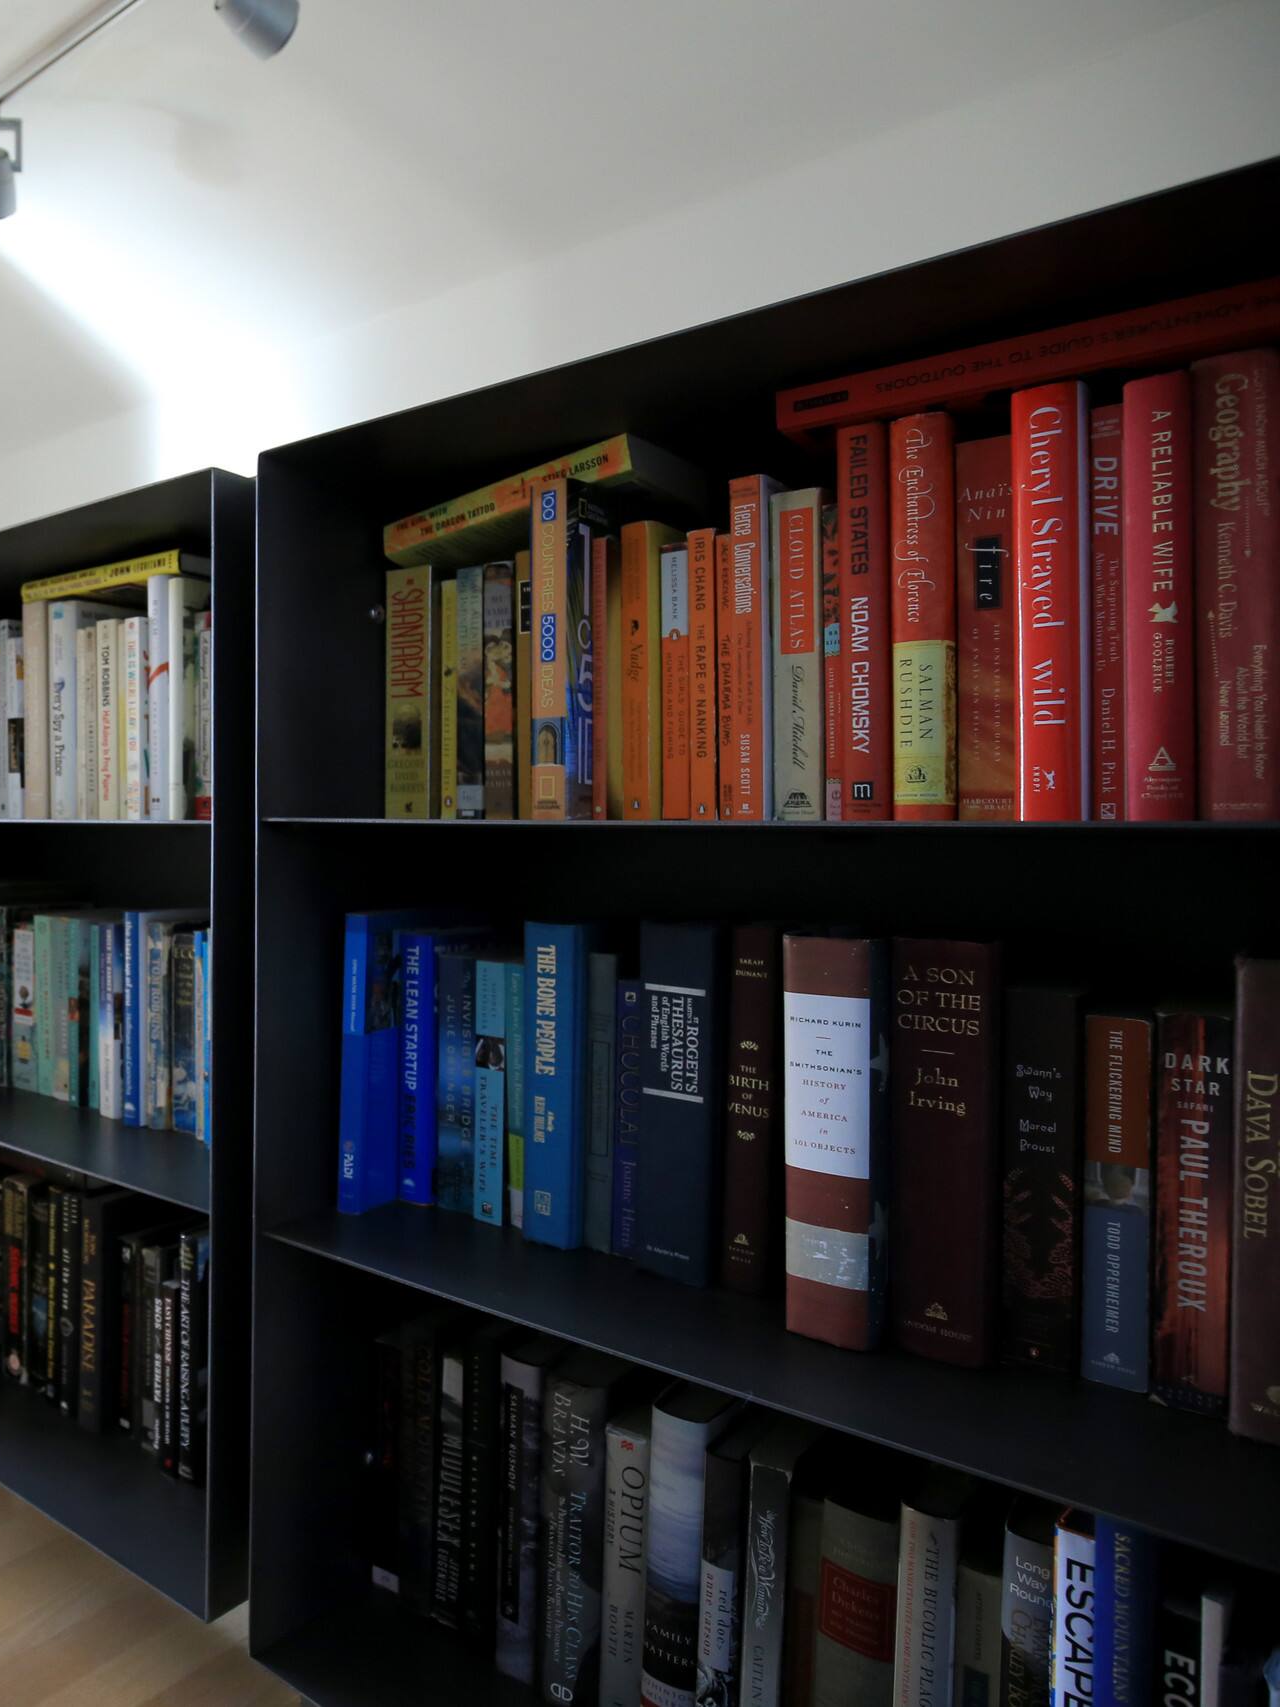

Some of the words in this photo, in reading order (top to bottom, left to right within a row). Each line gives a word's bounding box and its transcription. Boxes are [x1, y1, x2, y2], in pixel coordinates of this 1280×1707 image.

[1151, 410, 1173, 422] A
[1022, 406, 1064, 507] Cheryl
[1209, 372, 1252, 512] Geography
[849, 434, 869, 499] FAILED
[1151, 429, 1174, 534] RELIABLE
[541, 491, 556, 521] 100
[1093, 455, 1119, 536] DRiVE
[733, 502, 757, 537] Fierce
[966, 506, 1007, 523] Nin
[695, 536, 706, 562] IRIS
[788, 514, 805, 580] CLOUD
[849, 505, 870, 576] STATES
[1217, 521, 1239, 581] Kenneth
[541, 525, 555, 611] COUNTRIES
[733, 541, 758, 616] Conversations
[964, 541, 1010, 601] fire
[1022, 516, 1066, 629] Strayed
[1151, 539, 1175, 592] WIFE
[695, 567, 706, 611] CHANG
[1217, 582, 1237, 599] C.
[541, 614, 556, 663] 5000
[697, 624, 705, 641] THE
[789, 591, 806, 649] ATLAS
[851, 595, 870, 653] NOAM
[1217, 601, 1241, 640] Davis
[101, 644, 111, 666] TOM
[391, 587, 424, 699] SHANTARAM
[696, 644, 707, 679] RAPE
[1164, 638, 1175, 685] ROBERT
[627, 641, 644, 683] Nudge
[101, 667, 111, 707] ROBBINS
[541, 667, 554, 710] IDEAS
[697, 683, 705, 695] OF
[791, 664, 806, 713] David
[899, 659, 913, 749] RUSHDIE
[919, 663, 934, 740] SALMAN
[1031, 657, 1067, 727] wild
[53, 713, 65, 733] Spy
[851, 660, 871, 755] CHOMSKY
[1101, 688, 1116, 734] Daniel
[696, 698, 708, 759] NANKING
[791, 714, 808, 771] Mitchell
[1102, 738, 1116, 755] H.
[54, 743, 65, 777] Prince
[739, 733, 750, 764] SUSAN
[739, 767, 751, 796] SCOTT
[1102, 761, 1117, 794] Pink
[405, 945, 420, 975] THE
[535, 944, 556, 974] THE
[735, 968, 768, 980] DUNANT
[738, 957, 765, 967] SARAH
[903, 964, 919, 981] A
[926, 967, 976, 986] SON
[404, 978, 419, 1019] LEAN
[535, 976, 556, 1017] BONE
[651, 994, 660, 1013] and
[661, 996, 670, 1006] of
[896, 988, 929, 1006] OF
[935, 991, 982, 1012] THE
[650, 1014, 660, 1049] Phrases
[660, 1006, 671, 1041] English
[789, 1015, 830, 1026] RICHARD
[831, 1020, 862, 1029] KURIN
[896, 1013, 981, 1037] CIRCUS
[1108, 1030, 1122, 1051] THE
[403, 1023, 418, 1091] STARTUP
[534, 1019, 556, 1077] PEOPLE
[660, 1042, 671, 1073] Words
[671, 996, 685, 1092] THESAURUS
[815, 1048, 833, 1057] THE
[620, 1015, 643, 1148] CHOCOLAT
[739, 1064, 757, 1075] THE
[789, 1060, 863, 1076] SMITHSONIAN'S
[914, 1066, 960, 1088] John
[1015, 1064, 1063, 1080] Swann's
[1164, 1052, 1230, 1075] DARK
[728, 1073, 770, 1092] BIRTH
[741, 1092, 753, 1101] OF
[802, 1078, 847, 1091] HISTORY
[1028, 1085, 1053, 1103] Way
[1108, 1053, 1123, 1122] FLICKERING
[1170, 1077, 1221, 1096] STAR
[403, 1093, 416, 1128] ERIC
[480, 1075, 488, 1154] TRAVELER'S
[728, 1102, 770, 1119] VENUS
[800, 1109, 848, 1123] AMERICA
[907, 1090, 967, 1117] Irving
[1175, 1100, 1214, 1113] SAFARI
[1244, 1069, 1279, 1144] DAVA
[1019, 1118, 1057, 1133] Marcel
[1108, 1123, 1123, 1155] MIND
[402, 1134, 415, 1169] RIES
[794, 1138, 808, 1147] 101
[809, 1140, 856, 1155] OBJECTS
[1019, 1138, 1056, 1154] Proust
[1178, 1118, 1210, 1181] PAUL
[343, 1152, 354, 1180] PADI
[479, 1161, 487, 1192] WIFE
[620, 1159, 636, 1204] Joanne
[1243, 1155, 1278, 1241] SOBEL
[621, 1207, 635, 1249] Harris
[1106, 1220, 1121, 1250] TODD
[1177, 1195, 1210, 1312] THEROUX
[1104, 1252, 1121, 1334] OPPENHEIMER
[80, 1278, 97, 1370] PARADISE
[508, 1392, 519, 1438] SALMAN
[551, 1391, 573, 1477] BRANDS
[507, 1442, 518, 1491] RUSHDIE
[435, 1432, 463, 1548] MIDDLESEX
[568, 1490, 588, 1566] TRAITOR
[618, 1465, 645, 1575] OPIUM
[569, 1570, 581, 1590] to
[925, 1547, 940, 1582] THE
[1015, 1555, 1051, 1581] Long
[1016, 1571, 1048, 1593] Way
[1113, 1532, 1132, 1598] SACRED
[566, 1590, 585, 1625] HIS
[705, 1572, 715, 1606] anne
[718, 1589, 731, 1614] red
[607, 1604, 619, 1657] BOOTH
[622, 1609, 635, 1665] MARTIN
[703, 1610, 713, 1657] carson
[716, 1619, 730, 1651] doc>
[921, 1586, 937, 1662] BUCOLIC
[1064, 1557, 1095, 1707] ESCAPE
[564, 1626, 583, 1681] CLASS
[1111, 1599, 1130, 1703] MOUNTAINS
[751, 1645, 768, 1701] CAITLIN
